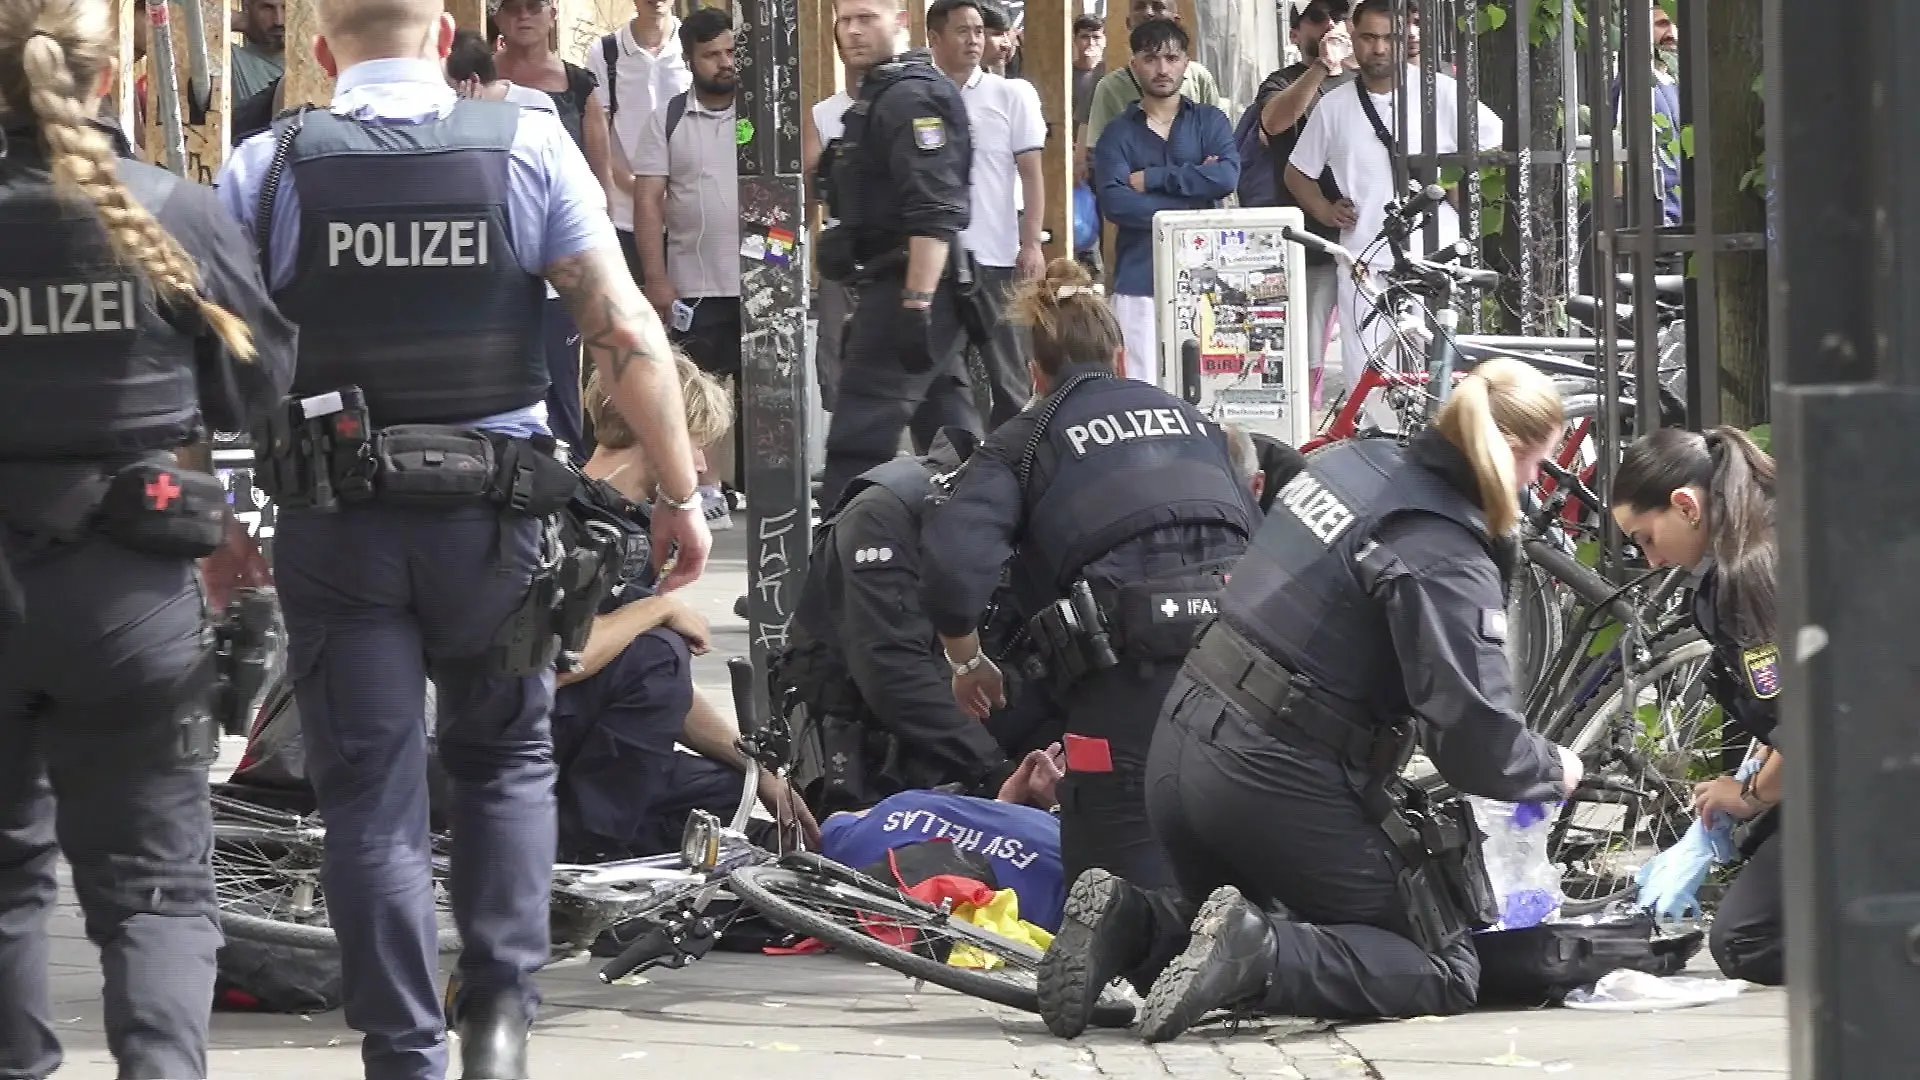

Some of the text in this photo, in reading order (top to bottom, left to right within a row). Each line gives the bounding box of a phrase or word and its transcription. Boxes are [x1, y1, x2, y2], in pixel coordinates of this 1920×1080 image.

[328, 221, 489, 267] POLIZEI
[0, 281, 136, 336] OLIZEI
[1065, 408, 1192, 455] POLIZEI
[883, 809, 1040, 871] FSV HELLAS
